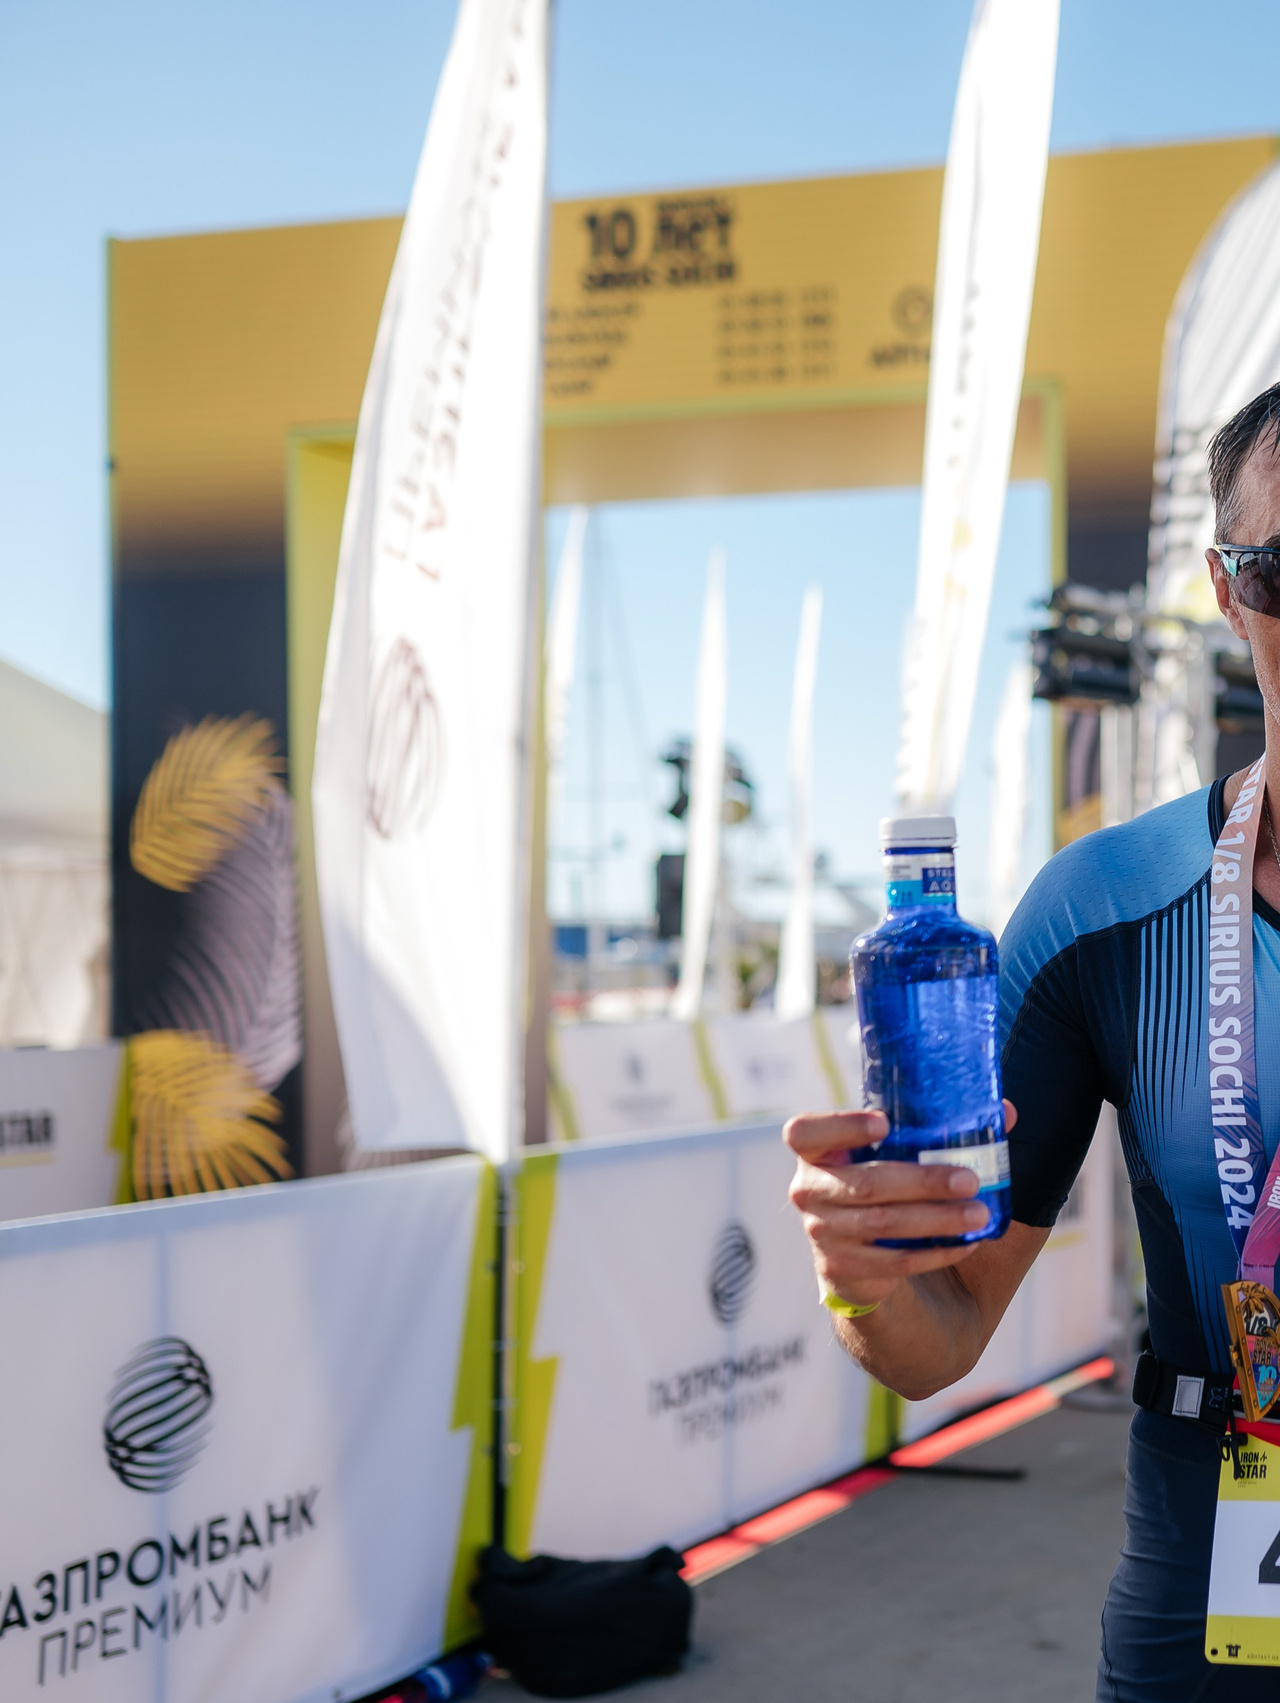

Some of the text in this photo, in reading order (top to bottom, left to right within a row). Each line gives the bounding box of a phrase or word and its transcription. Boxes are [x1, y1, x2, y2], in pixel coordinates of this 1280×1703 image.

[1210, 830, 1245, 884] 1/8
[1209, 893, 1241, 1007] SIRIUS
[1208, 1016, 1247, 1126] SOCHI
[1214, 1138, 1256, 1230] 2024
[1253, 1351, 1272, 1365] STAR
[1239, 1464, 1267, 1479] STAR
[1240, 1452, 1260, 1463] IRON
[0, 1483, 320, 1640] АЗПРОМБАНК
[37, 1560, 273, 1687] ПРЕМИУМ
